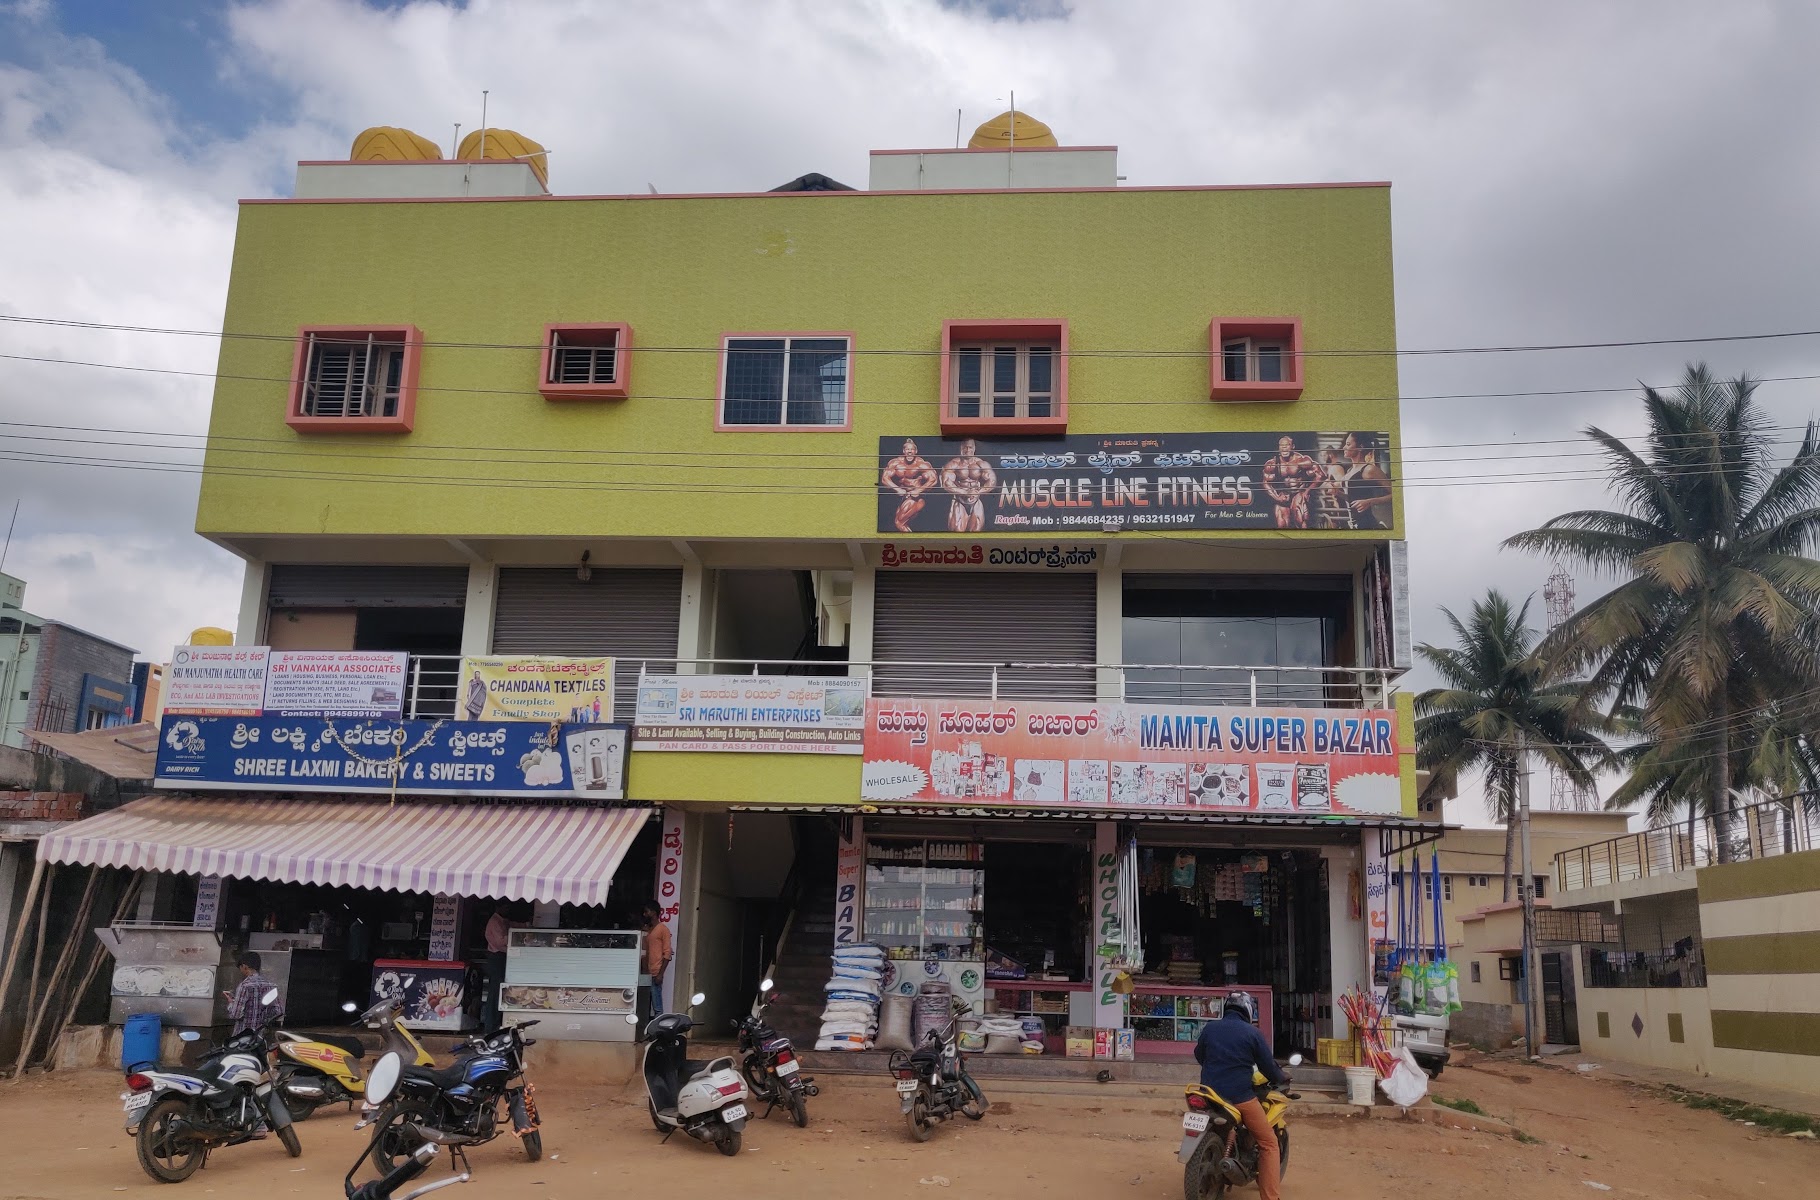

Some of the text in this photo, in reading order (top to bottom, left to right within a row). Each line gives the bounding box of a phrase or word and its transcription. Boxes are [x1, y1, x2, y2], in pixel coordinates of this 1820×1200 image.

[999, 476, 1253, 508] MUSCLE LINE FITNESS
[1032, 516, 1053, 525] Mob
[1063, 516, 1124, 525] 9844684235
[1133, 514, 1195, 524] 9632151947
[173, 668, 263, 679] SRI MANJUNATHA HEALTH CARE
[343, 665, 402, 673] ASSOCIATES
[490, 679, 606, 693] CHANDANA TEXTILES
[492, 710, 560, 718] Family Shop
[679, 708, 821, 723] SRI MARUTHI ENTERPRISES
[939, 707, 1016, 734] ಸೂಪರ್
[1028, 709, 1098, 736] ಬಜಾರ್
[230, 723, 260, 749] ಶ್ರೀ
[344, 724, 408, 745] ಬೇಕರಿ
[638, 728, 861, 741] Site & Land Available, Selling & Buying, Building Construction, Auto Links
[1140, 714, 1393, 755] MAMTA SUPER BAZAR
[234, 759, 495, 782] SHREE LAXMI BAKERY & SWEETS
[866, 774, 918, 787] WHOLESALE
[839, 865, 858, 878] Super
